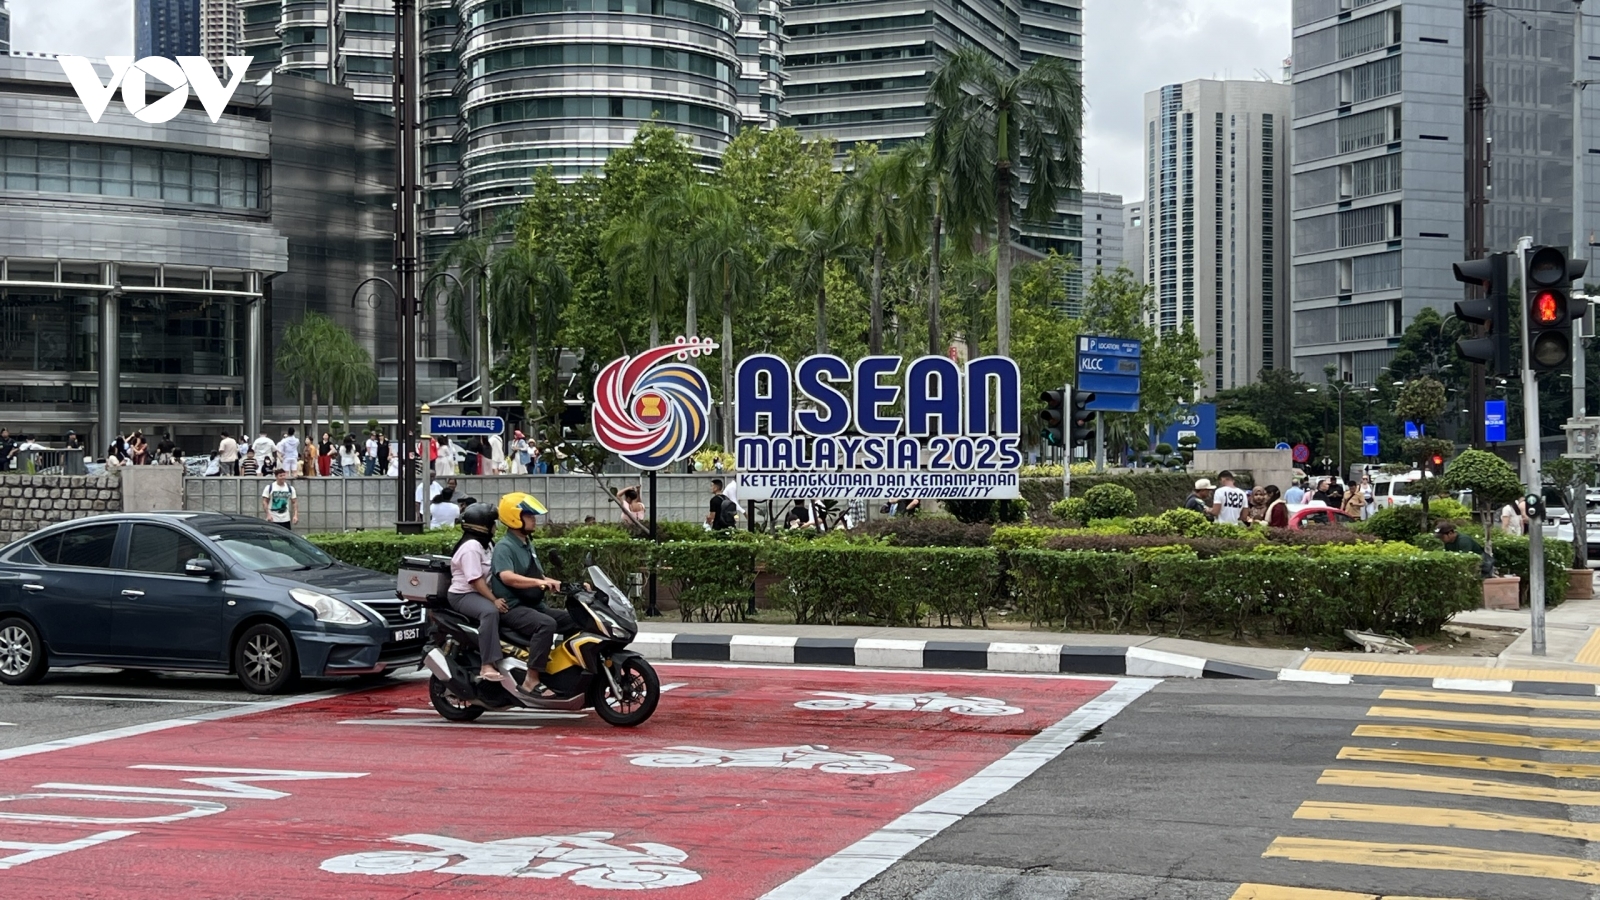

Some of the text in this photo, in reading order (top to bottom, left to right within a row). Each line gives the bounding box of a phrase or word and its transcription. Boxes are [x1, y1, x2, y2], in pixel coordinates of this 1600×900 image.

[1082, 358, 1103, 370] KLCC
[735, 354, 1021, 436] ASEAN
[438, 420, 461, 428] JALAN
[736, 437, 1022, 471] MALAYSIA 2025
[740, 474, 1016, 487] KETERANGKUMAN DAN KEMAMPANAN
[770, 487, 993, 498] INCLUSIVITY AND SUSTAINABILITY
[1224, 491, 1244, 508] 1928
[403, 629, 415, 639] 1525
[416, 628, 419, 638] T
